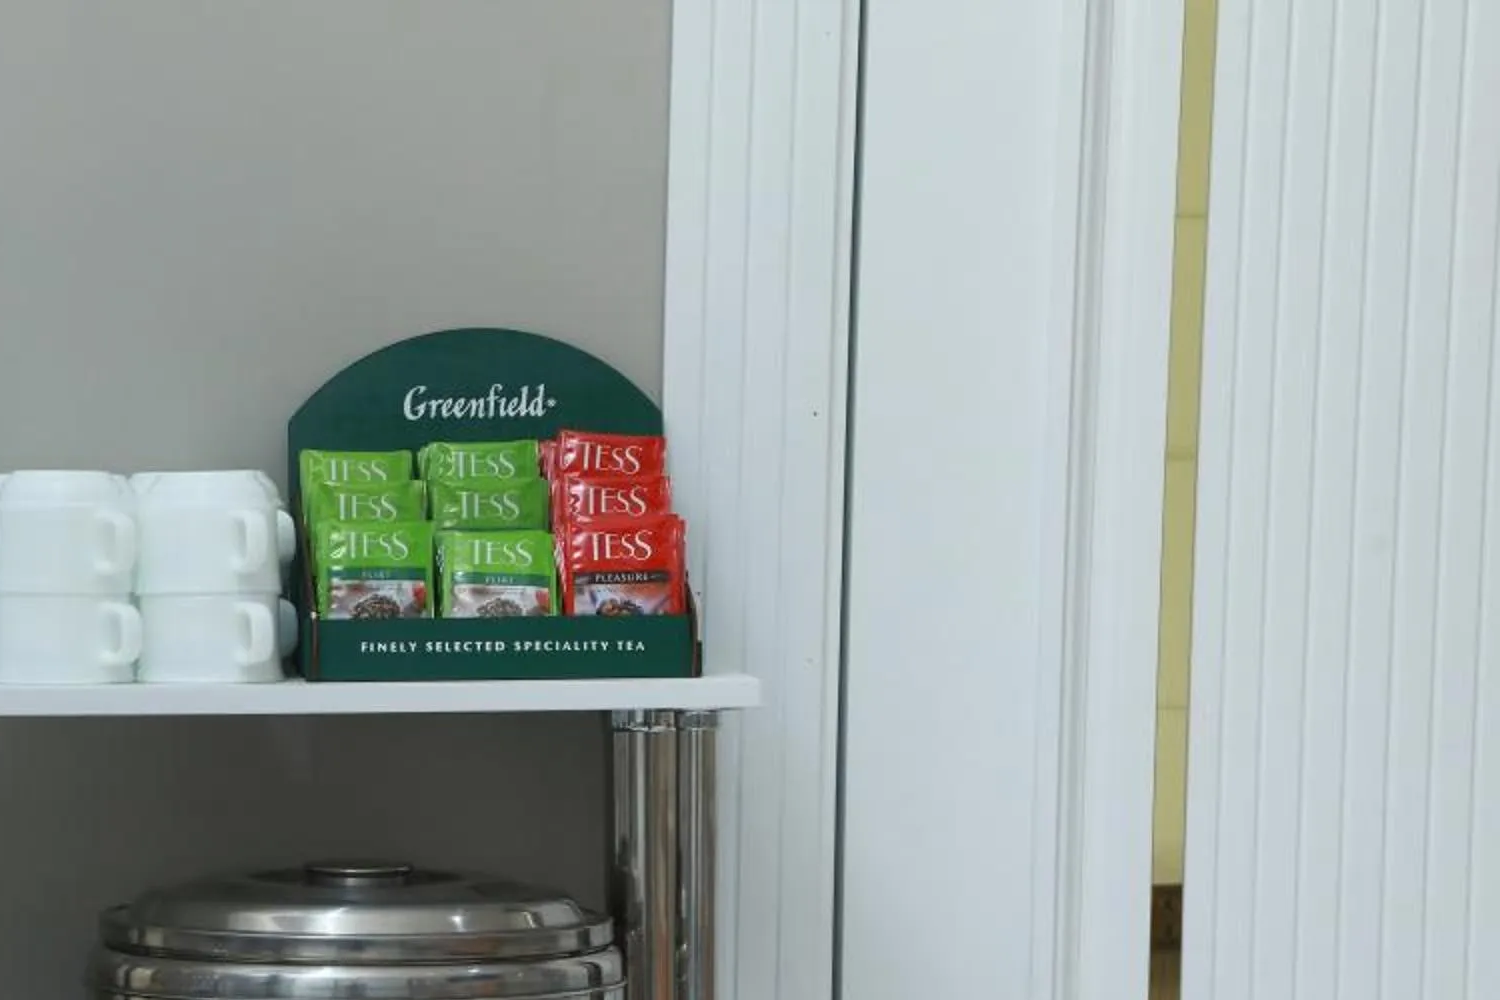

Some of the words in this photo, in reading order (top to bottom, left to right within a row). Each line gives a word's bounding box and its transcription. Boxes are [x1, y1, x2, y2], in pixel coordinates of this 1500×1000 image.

[403, 383, 547, 420] Greenfield
[453, 449, 515, 478] TESS
[577, 441, 643, 475] TESS
[457, 490, 520, 520] TESS
[585, 484, 648, 517] TESS
[345, 529, 409, 560] TESS
[469, 537, 534, 567] TESS
[587, 529, 653, 561] TESS
[595, 572, 649, 583] PLEASURE
[361, 641, 417, 652] FINELY
[425, 641, 506, 652] SELECTED
[513, 640, 610, 652] SPECIALITY
[617, 640, 646, 651] TEA
